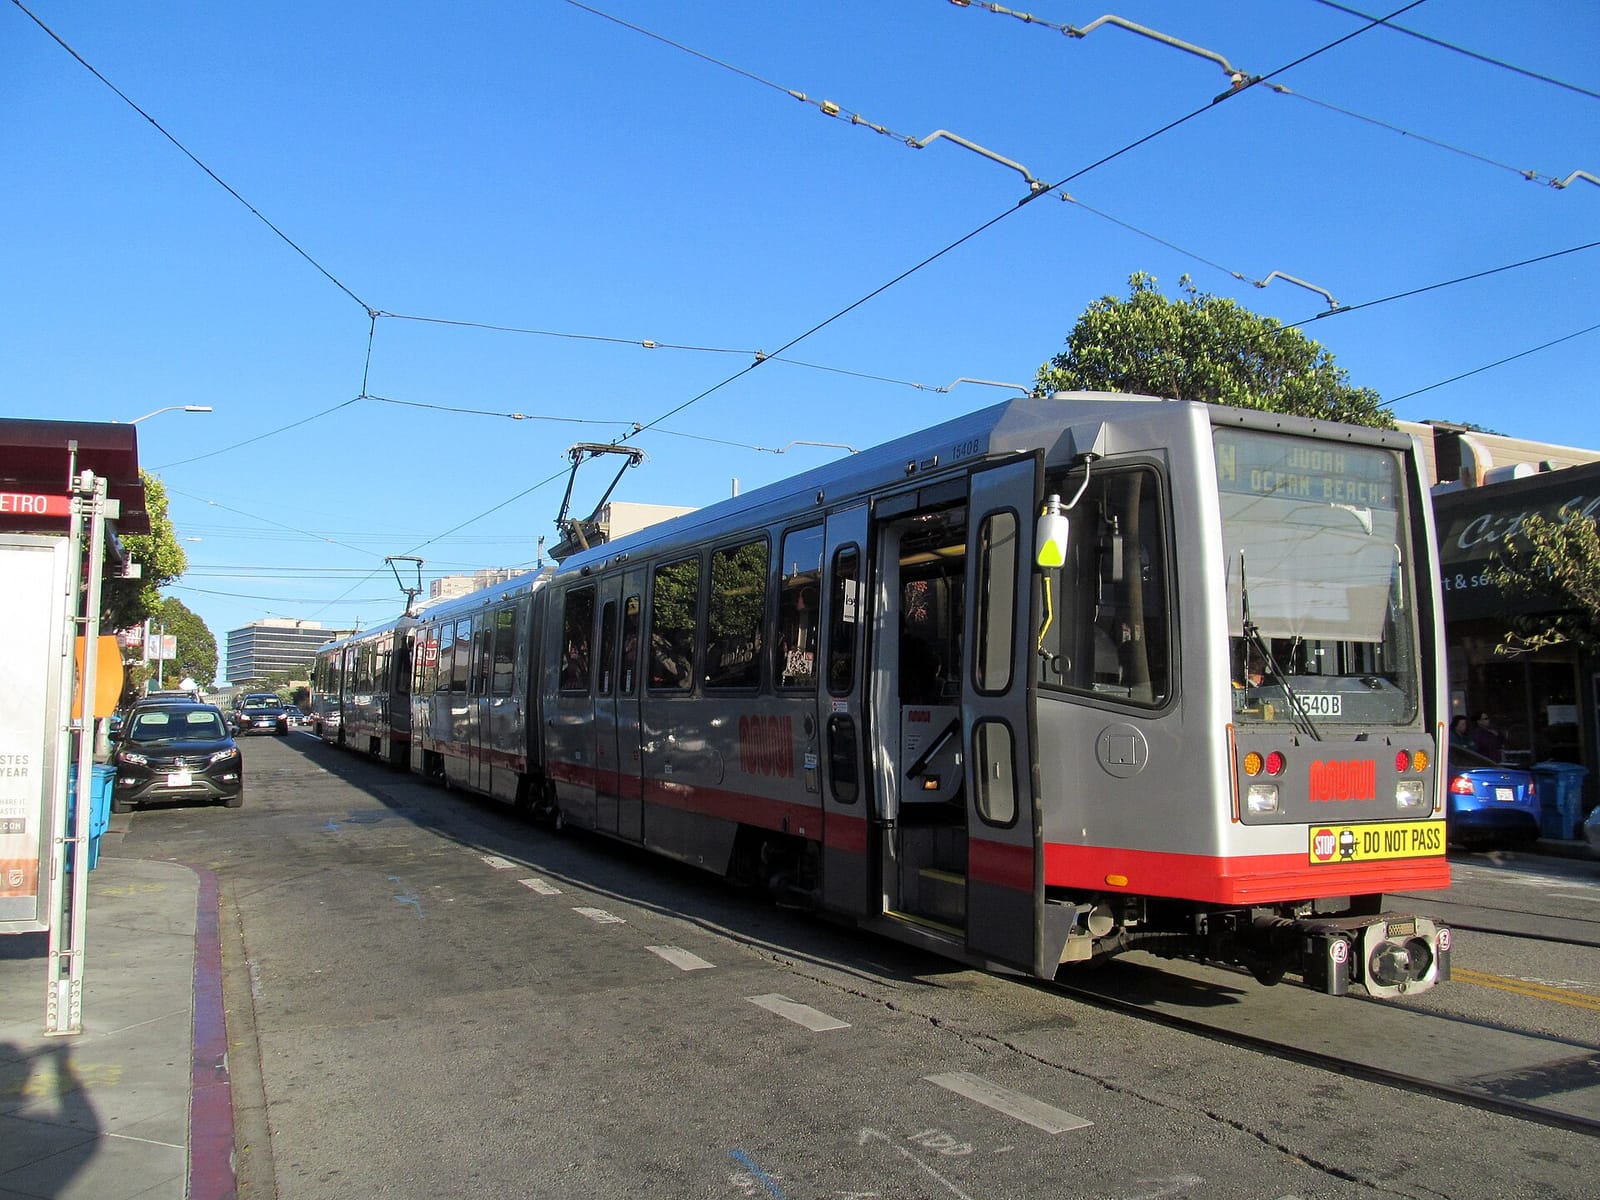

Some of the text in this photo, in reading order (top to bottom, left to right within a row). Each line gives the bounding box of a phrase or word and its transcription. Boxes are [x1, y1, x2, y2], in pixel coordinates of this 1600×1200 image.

[1219, 444, 1236, 481] N
[1251, 469, 1379, 503] OCEAN BEACH
[1455, 573, 1467, 589] &
[1315, 835, 1335, 855] STOP
[1363, 827, 1441, 854] DO NOT PASS
